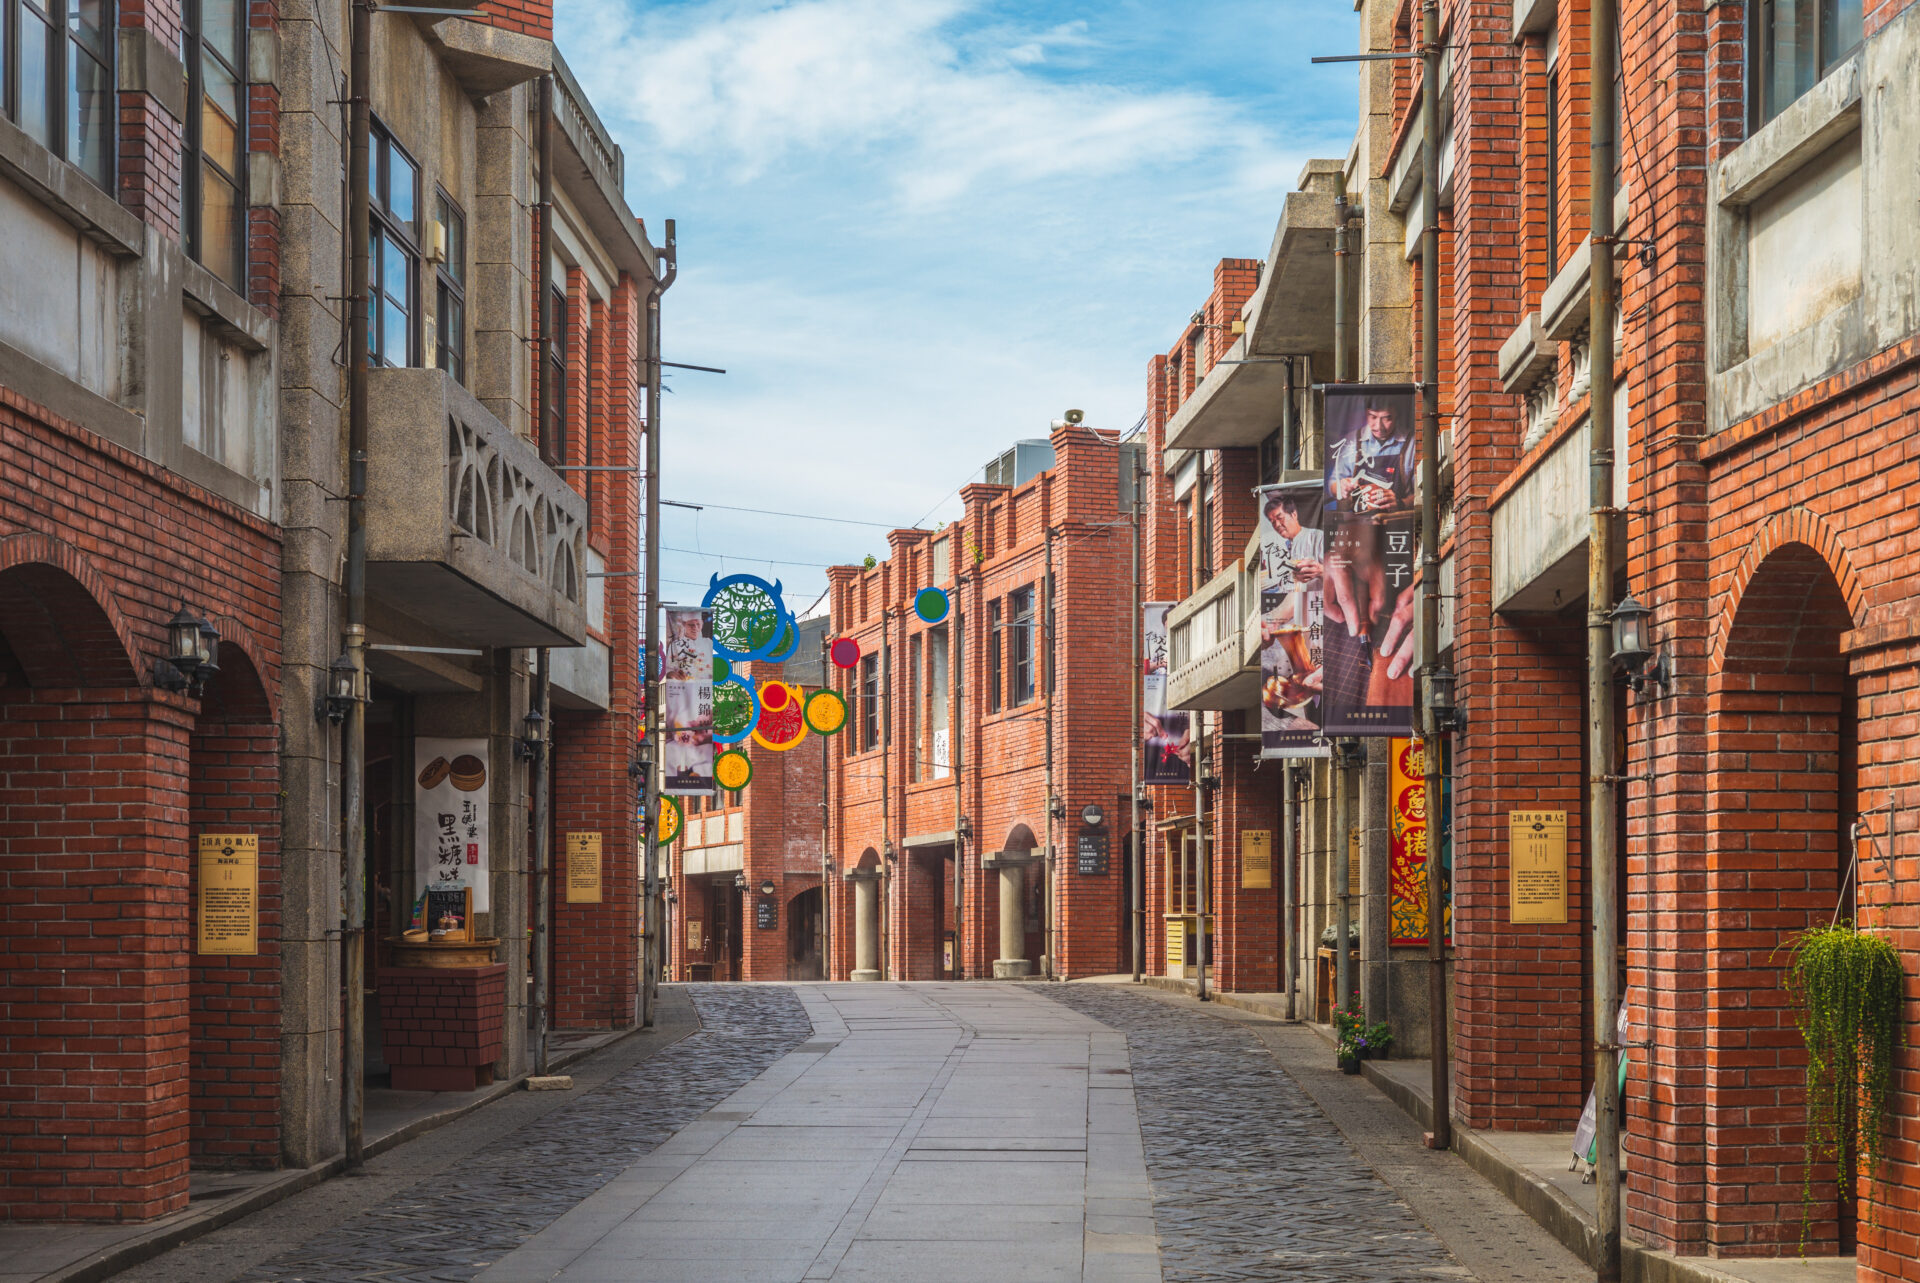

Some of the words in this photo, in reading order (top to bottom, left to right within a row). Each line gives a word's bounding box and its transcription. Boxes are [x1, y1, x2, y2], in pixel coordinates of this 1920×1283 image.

[1385, 530, 1411, 588] 豆子
[1545, 814, 1560, 823] 職人
[235, 838, 251, 846] 職人
